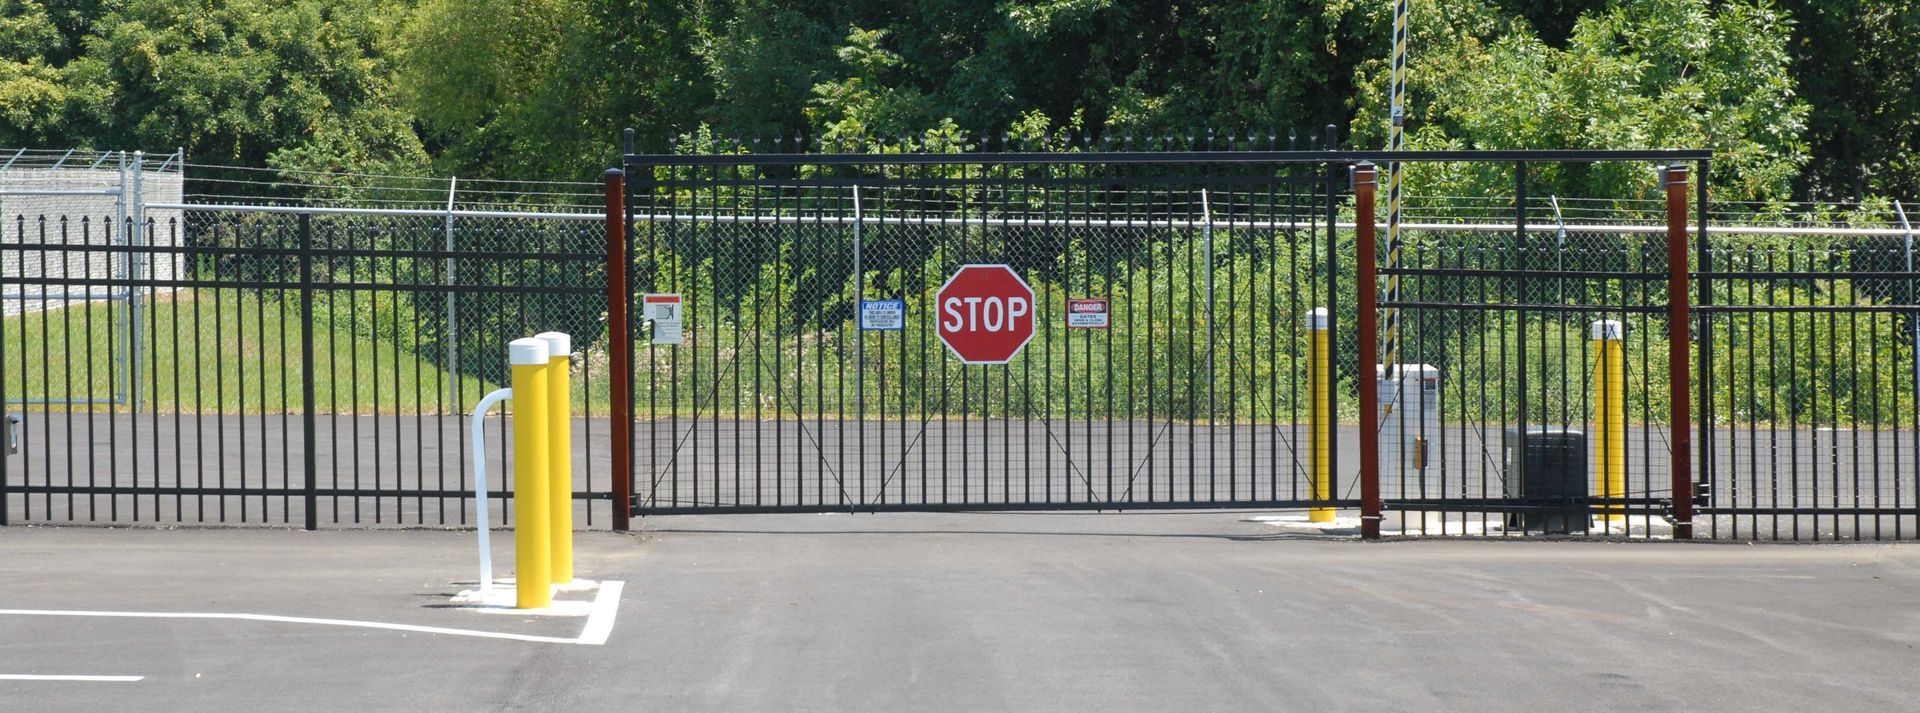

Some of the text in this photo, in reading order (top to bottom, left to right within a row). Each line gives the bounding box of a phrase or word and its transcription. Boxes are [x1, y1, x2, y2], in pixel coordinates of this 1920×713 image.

[865, 302, 897, 310] NOTICE
[1074, 303, 1102, 311] DANGER
[944, 296, 1028, 333] STOP
